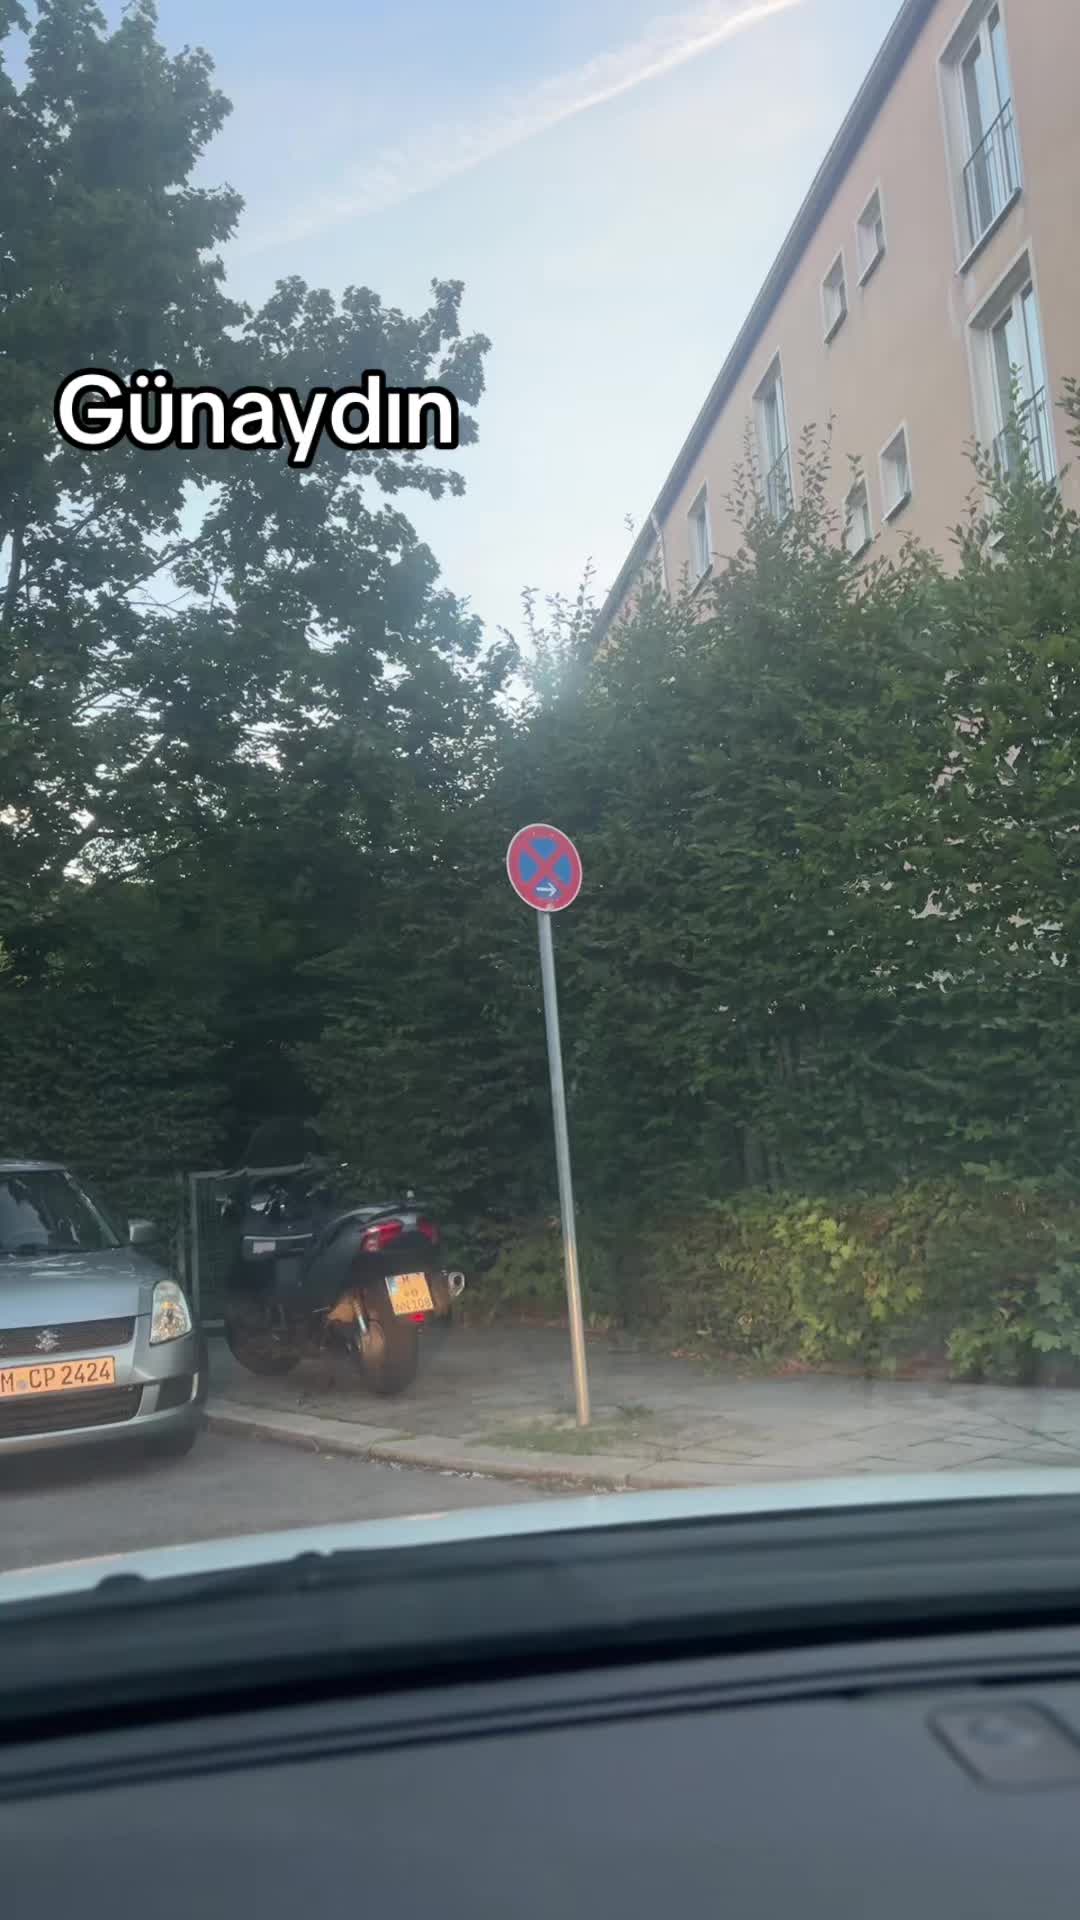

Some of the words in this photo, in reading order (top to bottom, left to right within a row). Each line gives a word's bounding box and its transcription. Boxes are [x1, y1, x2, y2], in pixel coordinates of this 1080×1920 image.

[0, 1372, 14, 1392] M
[29, 1367, 56, 1389] CP
[61, 1361, 111, 1385] 2424
